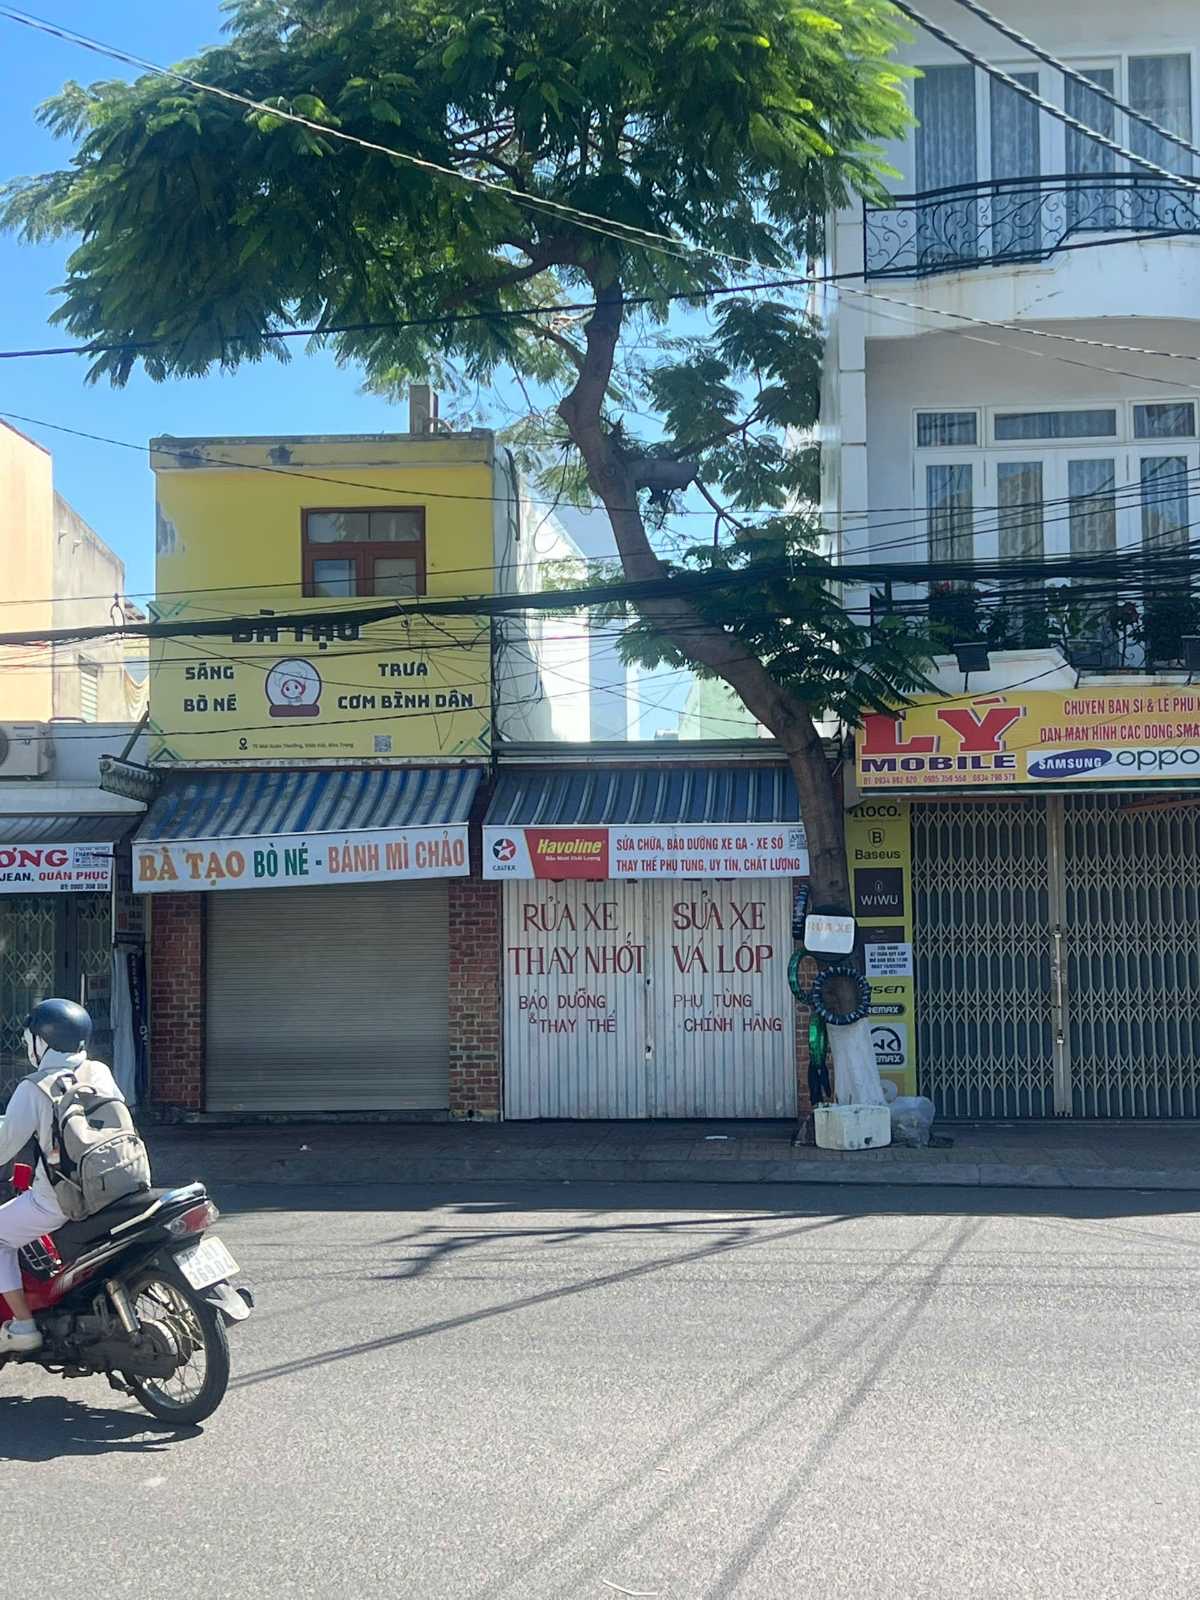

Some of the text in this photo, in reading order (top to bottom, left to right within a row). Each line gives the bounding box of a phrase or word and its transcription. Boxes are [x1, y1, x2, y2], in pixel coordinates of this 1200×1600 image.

[378, 662, 428, 677] TRƯA
[183, 694, 237, 712] BÒ NÉ
[337, 690, 473, 709] CƠM BÌNH DÂN
[1147, 699, 1154, 712] &
[861, 755, 1015, 772] MOBILE
[1038, 757, 1101, 770] SAMSUNG
[537, 838, 602, 854] Havoline
[616, 834, 635, 850] SỬA
[721, 837, 733, 849] XE
[735, 837, 749, 849] GA
[756, 837, 769, 849] XE
[771, 834, 784, 849] SỐ
[138, 846, 179, 881] BÀ
[185, 850, 245, 886] TẠO
[253, 843, 278, 878] BÒ
[285, 842, 309, 876] NÉ
[328, 840, 379, 874] BÁNH
[385, 836, 409, 871] MÌ
[415, 830, 465, 869] CHẢO
[616, 859, 638, 871] THAY
[641, 855, 658, 871] THẾ
[709, 858, 722, 871] UY
[854, 849, 901, 860] Baseus
[523, 896, 619, 932] RỬA XE
[672, 890, 766, 930] SỬA XE
[508, 932, 647, 976] THAY NHỚT
[672, 935, 774, 973] VÁ LỐP
[712, 988, 752, 1008] TÙNG
[528, 1009, 616, 1033] & THAY THẾ
[684, 1011, 733, 1033] CHÍNH
